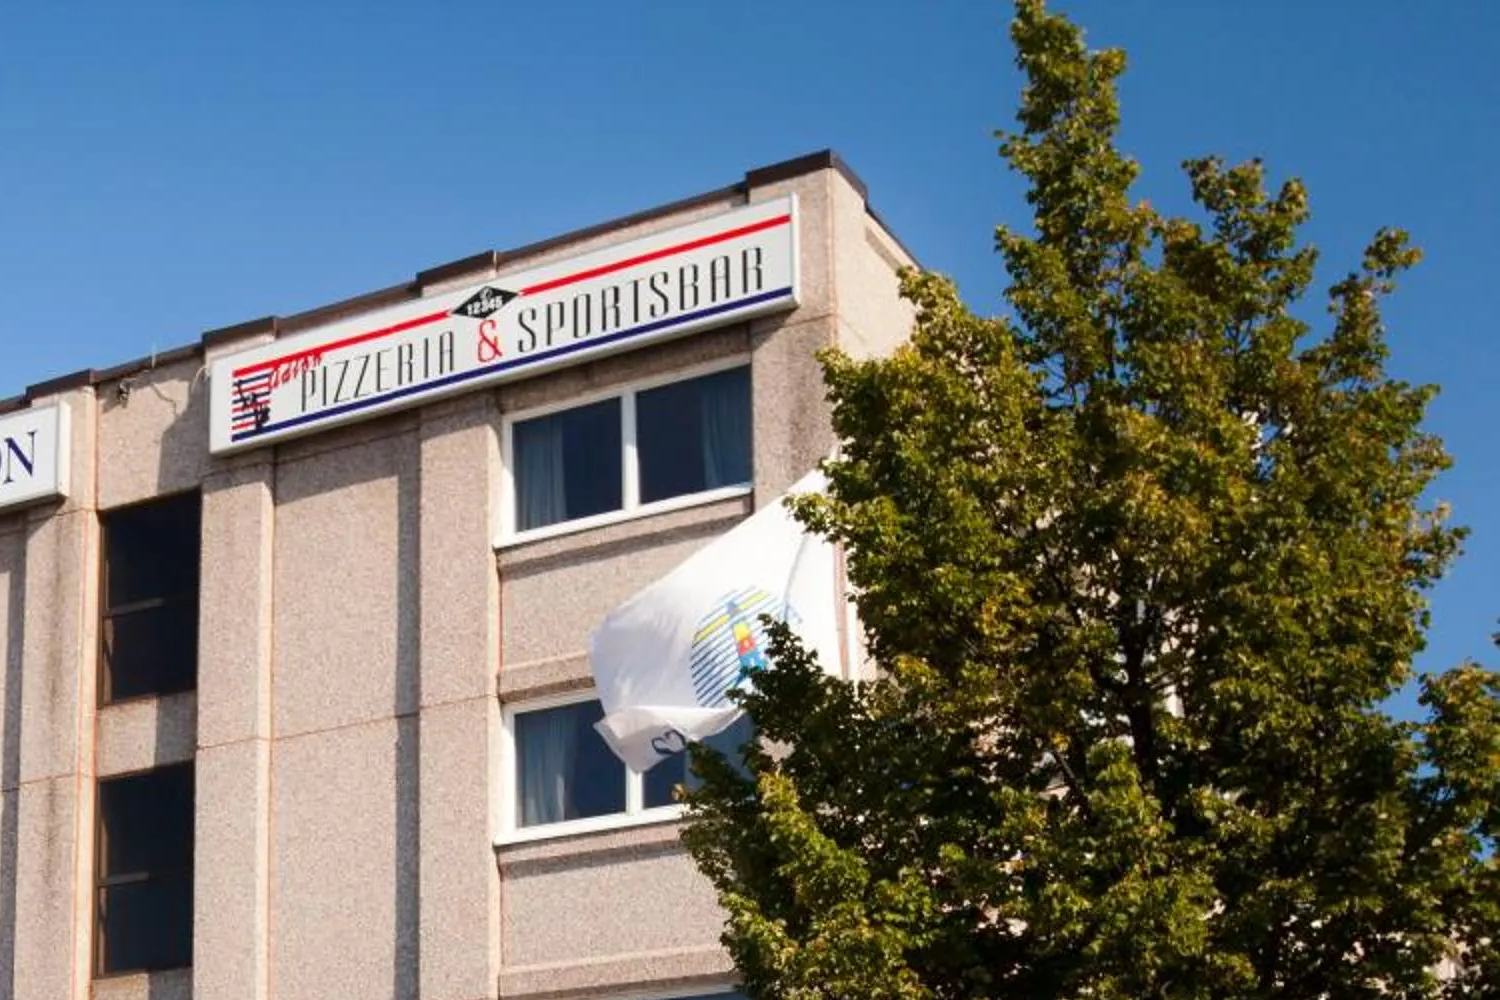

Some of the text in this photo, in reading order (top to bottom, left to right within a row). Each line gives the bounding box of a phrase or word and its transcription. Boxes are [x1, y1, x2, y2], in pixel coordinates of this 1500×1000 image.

[299, 245, 765, 413] PIZZERIA & SPORTSBAR
